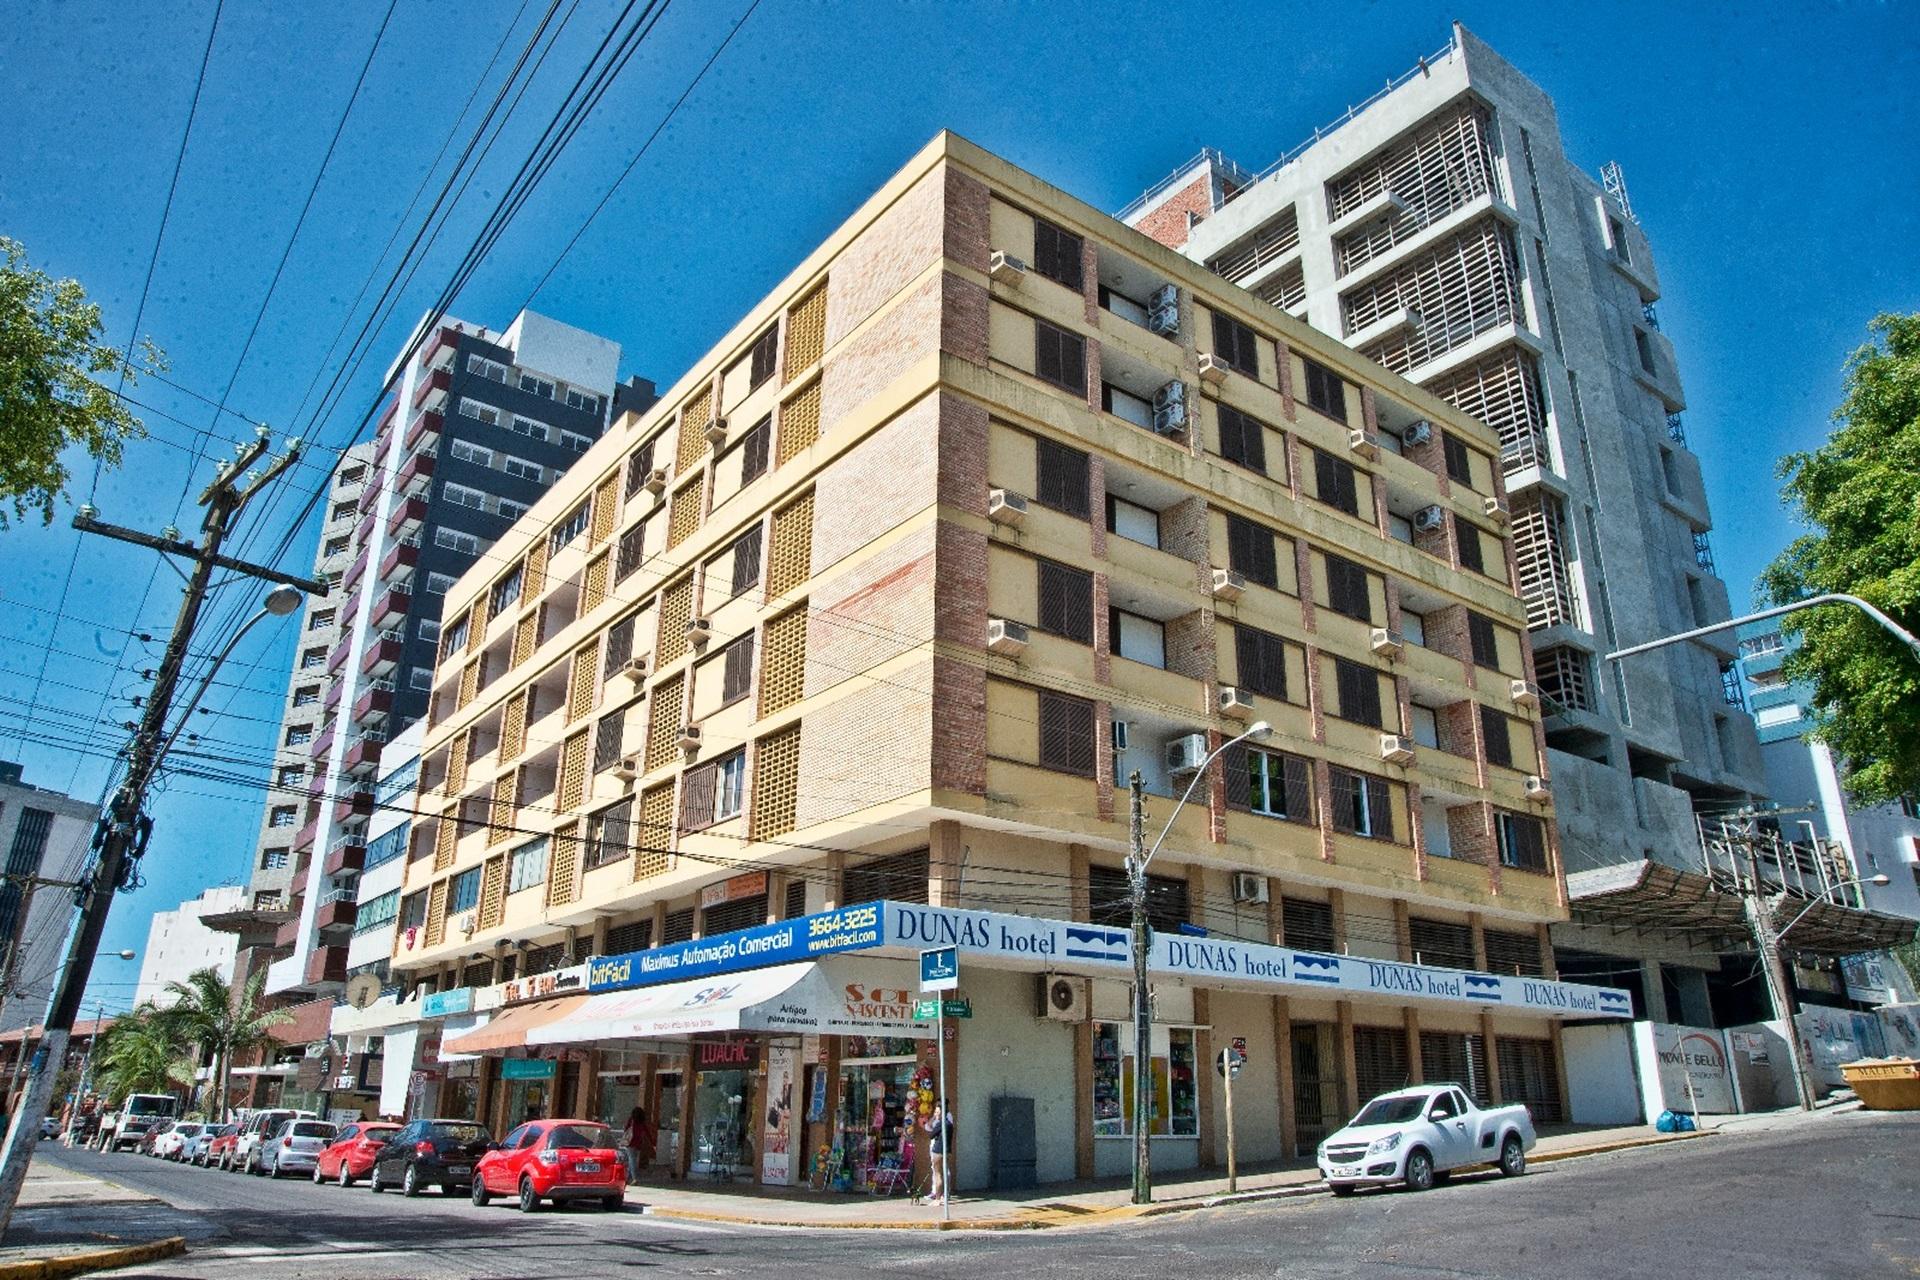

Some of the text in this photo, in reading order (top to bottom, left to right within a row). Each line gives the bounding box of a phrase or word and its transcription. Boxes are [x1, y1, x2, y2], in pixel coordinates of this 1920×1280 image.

[808, 906, 877, 937] 3664-3225
[896, 908, 1056, 954] DUNAS hotel
[591, 959, 631, 985] bitFácil
[641, 953, 679, 973] Maximus
[681, 940, 736, 965] Automação
[739, 927, 793, 955] Comercial
[1168, 940, 1287, 978] DUNAS hotel
[845, 983, 914, 1005] SOL
[1369, 963, 1460, 997] DUNAS hotel
[1523, 982, 1597, 1011] DUNAS hotel
